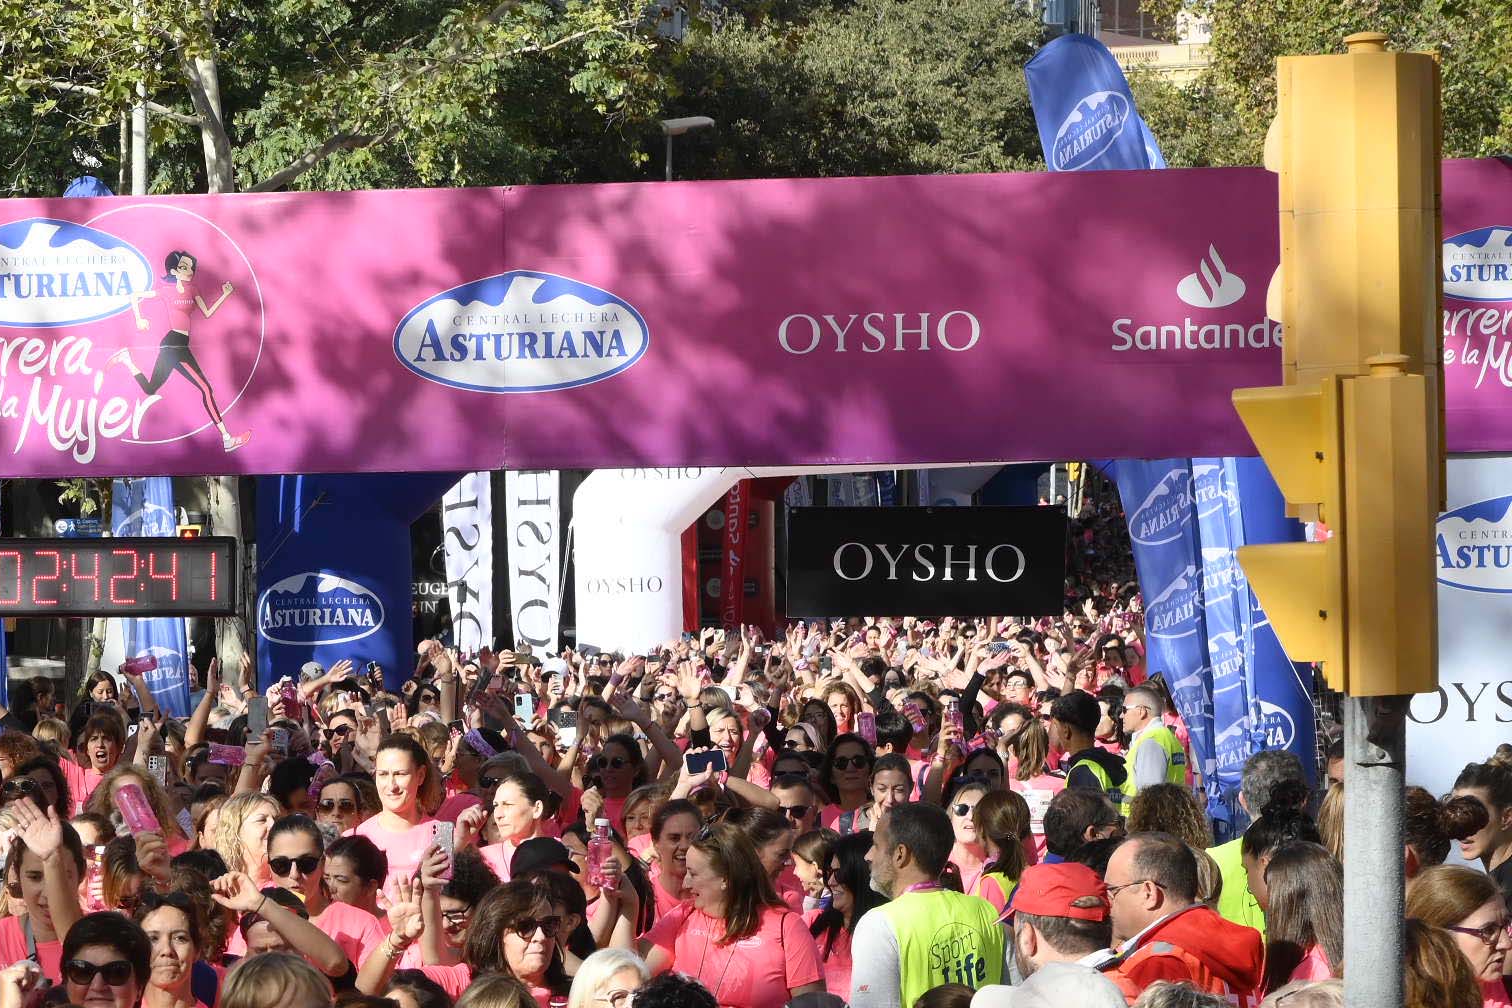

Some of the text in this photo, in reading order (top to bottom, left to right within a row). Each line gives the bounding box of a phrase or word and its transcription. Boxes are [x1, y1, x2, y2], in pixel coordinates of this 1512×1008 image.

[452, 311, 620, 327] CENTRAL LECHERA
[778, 311, 981, 355] OYSHO
[1111, 317, 1283, 351] Santande
[413, 318, 629, 364] ASTURIANA
[1461, 338, 1479, 365] la
[14, 371, 162, 464] Mujer
[832, 541, 1026, 584] OYSHO
[1436, 533, 1512, 569] ASTU
[322, 597, 370, 605] LECHERA
[587, 575, 662, 593] OYSHO
[263, 601, 375, 630] ASTURIANA
[931, 930, 976, 970] Sport
